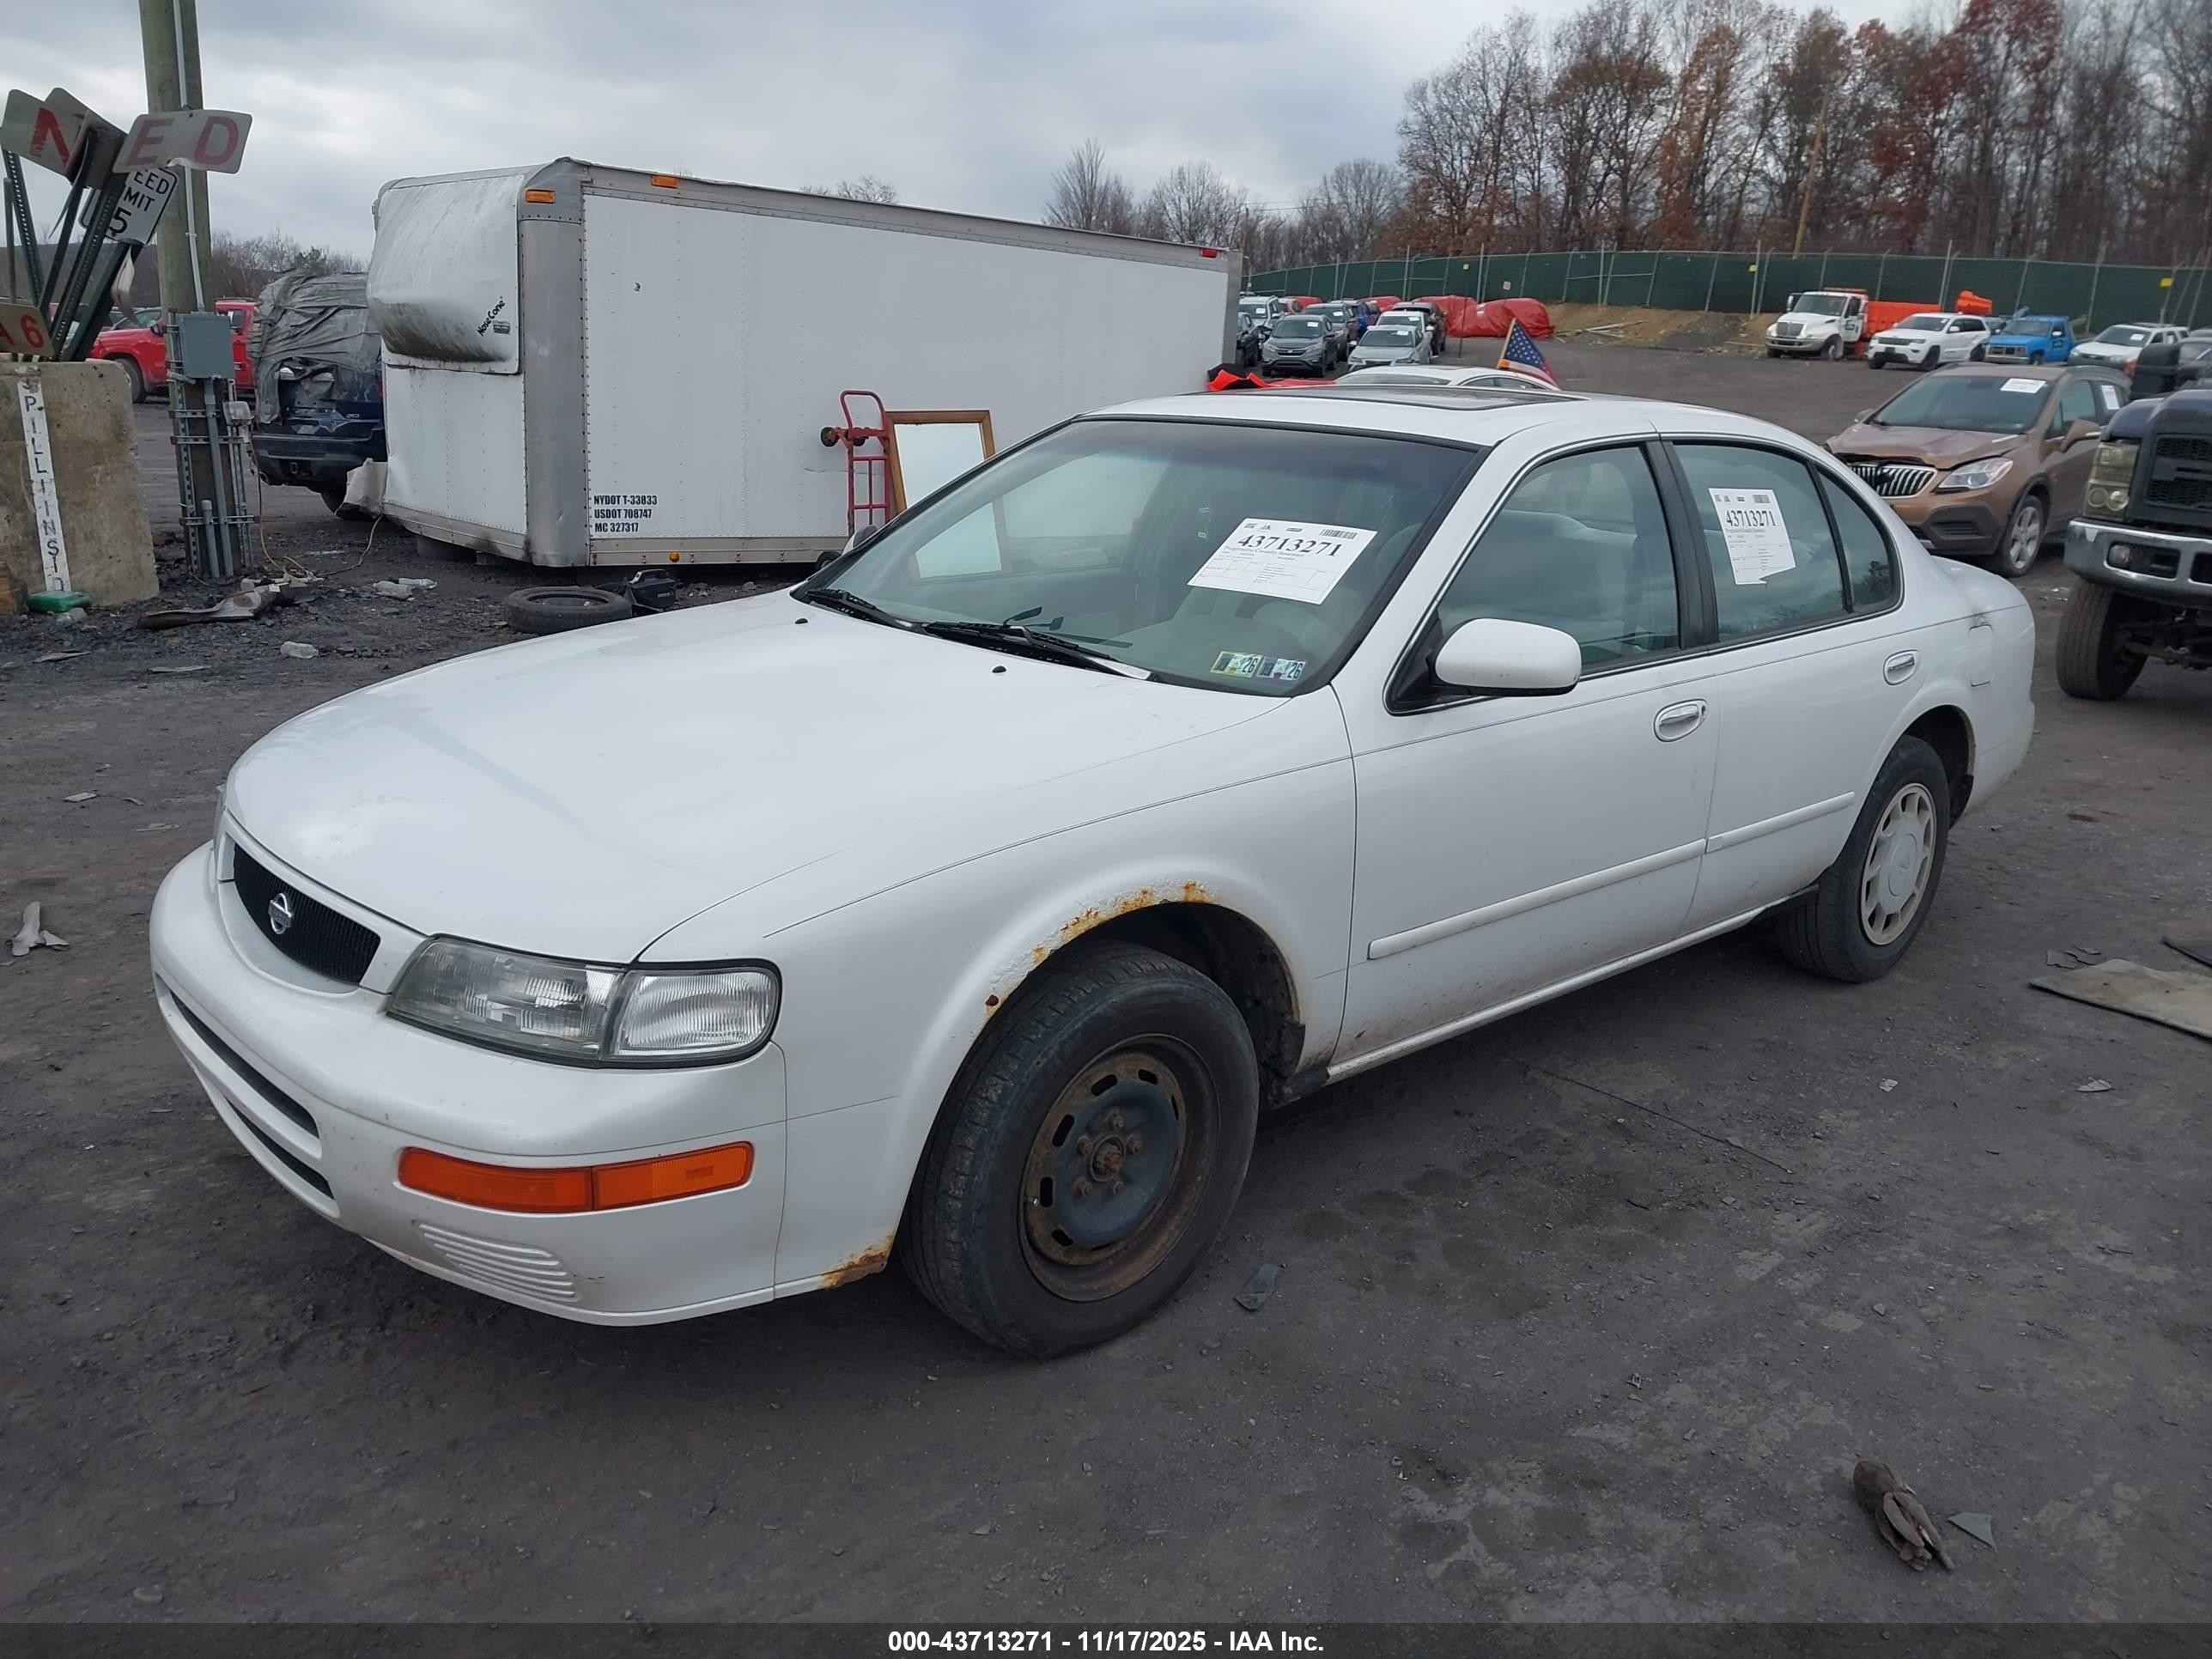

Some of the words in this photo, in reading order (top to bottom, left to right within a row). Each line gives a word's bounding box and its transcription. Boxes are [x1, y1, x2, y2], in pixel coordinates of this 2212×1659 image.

[134, 171, 170, 195] EED
[125, 186, 155, 212] MIT
[593, 495, 622, 506] NYDOT
[622, 495, 658, 506] T-33833
[593, 508, 622, 520] USDOT
[623, 508, 653, 520] 708747
[1725, 509, 1777, 527] 43713271
[594, 522, 609, 533] MC
[610, 522, 639, 533] 327317
[1237, 533, 1343, 558] 43713271
[1242, 657, 1260, 674] 26
[1287, 662, 1304, 679] 26
